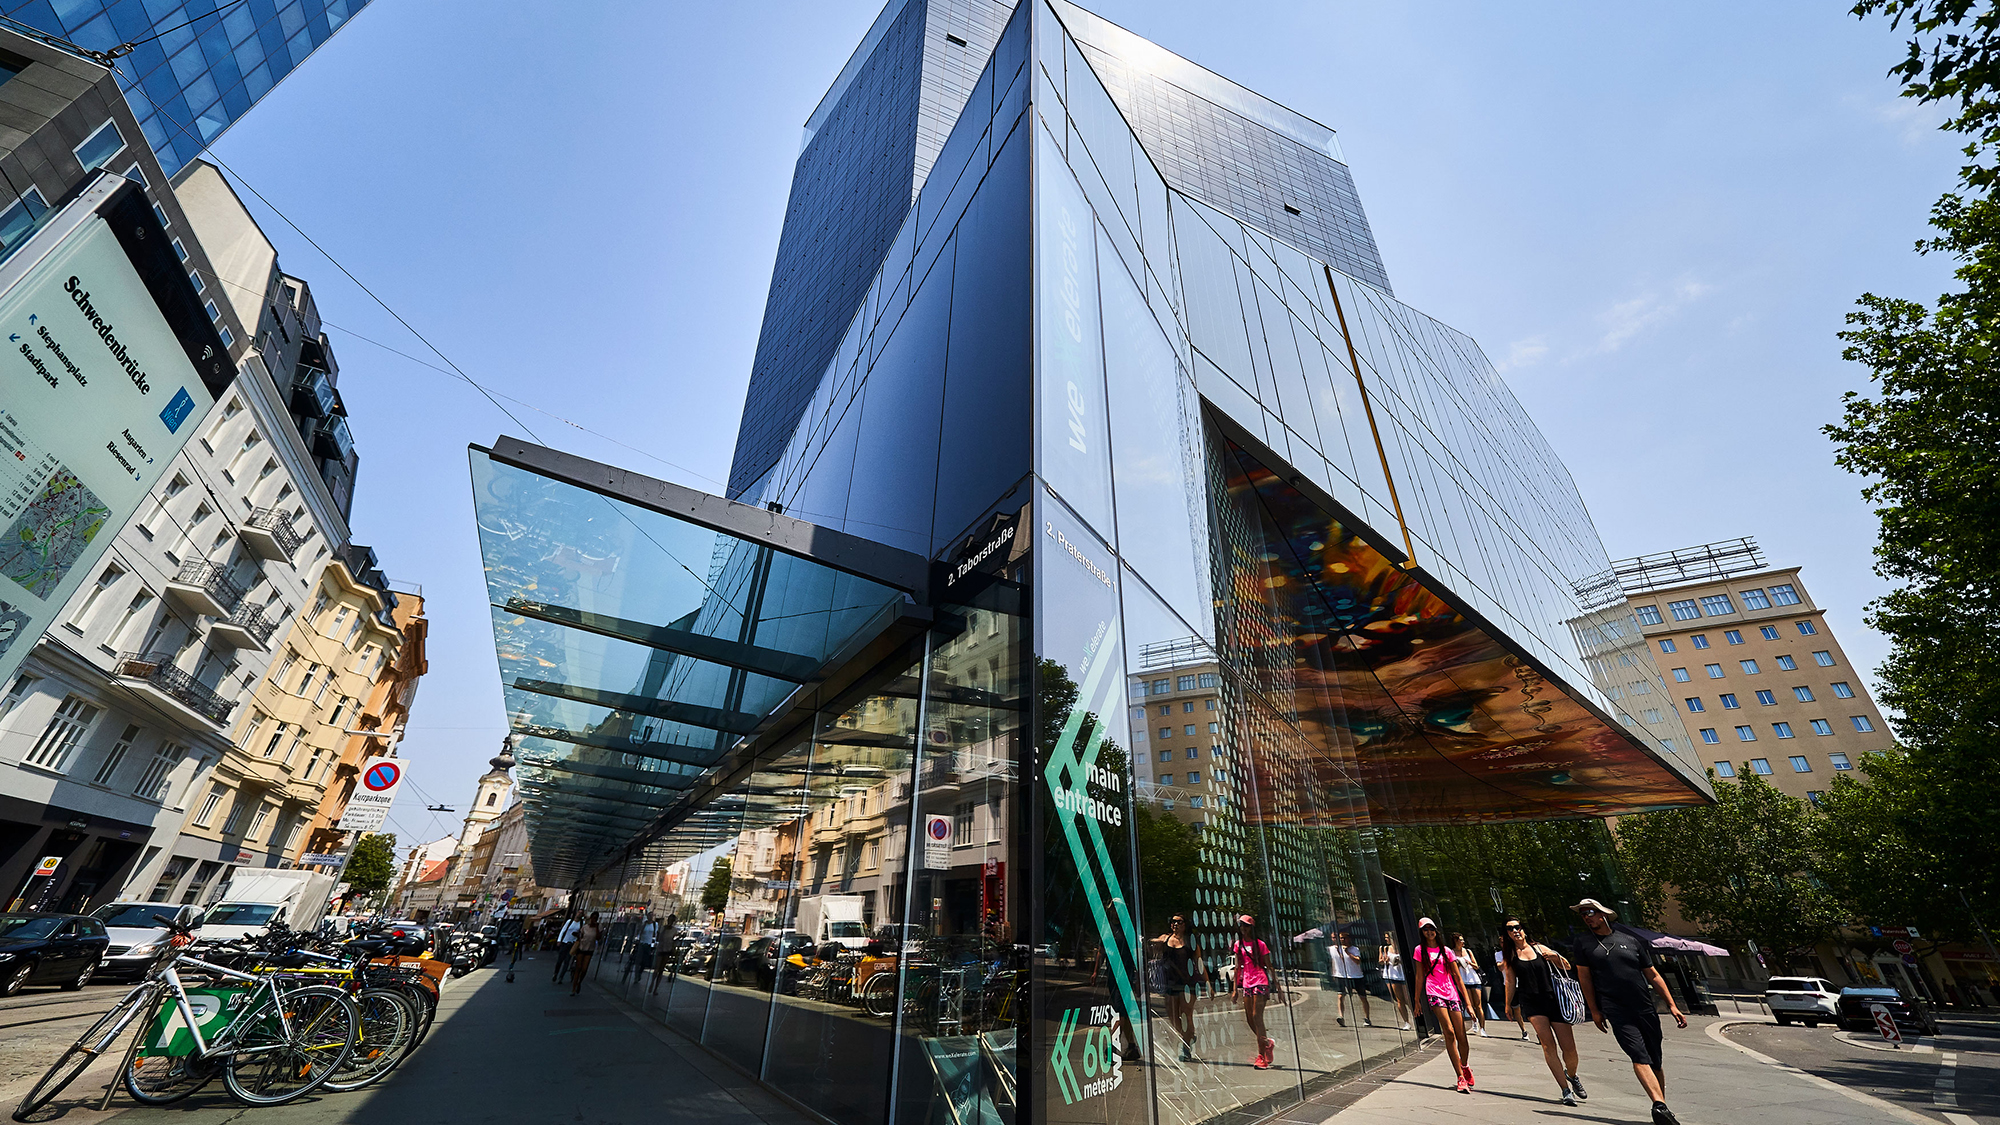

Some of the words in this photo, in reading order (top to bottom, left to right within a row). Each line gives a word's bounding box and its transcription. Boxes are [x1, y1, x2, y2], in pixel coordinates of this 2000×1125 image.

[36, 325, 89, 388] Stephansplatz
[64, 275, 151, 396] Schwedenbrücke
[19, 343, 60, 390] Stadtpark
[163, 410, 178, 430] Wien
[106, 440, 136, 475] Riesenrad
[121, 428, 148, 460] Augarten
[947, 572, 957, 587] 2.
[957, 525, 1014, 581] Taborstraße
[1046, 520, 1056, 538] 2.
[1057, 529, 1111, 589] Praterstraße
[1085, 760, 1120, 793] main
[353, 793, 392, 804] Kurzparkzone
[1054, 784, 1122, 827] entrance
[1895, 943, 1909, 951] STOP
[155, 994, 221, 1049] P
[1090, 1005, 1109, 1026] THIS
[1083, 1026, 1112, 1078] 60
[1111, 1004, 1123, 1090] WAY
[1083, 1076, 1115, 1100] meters
